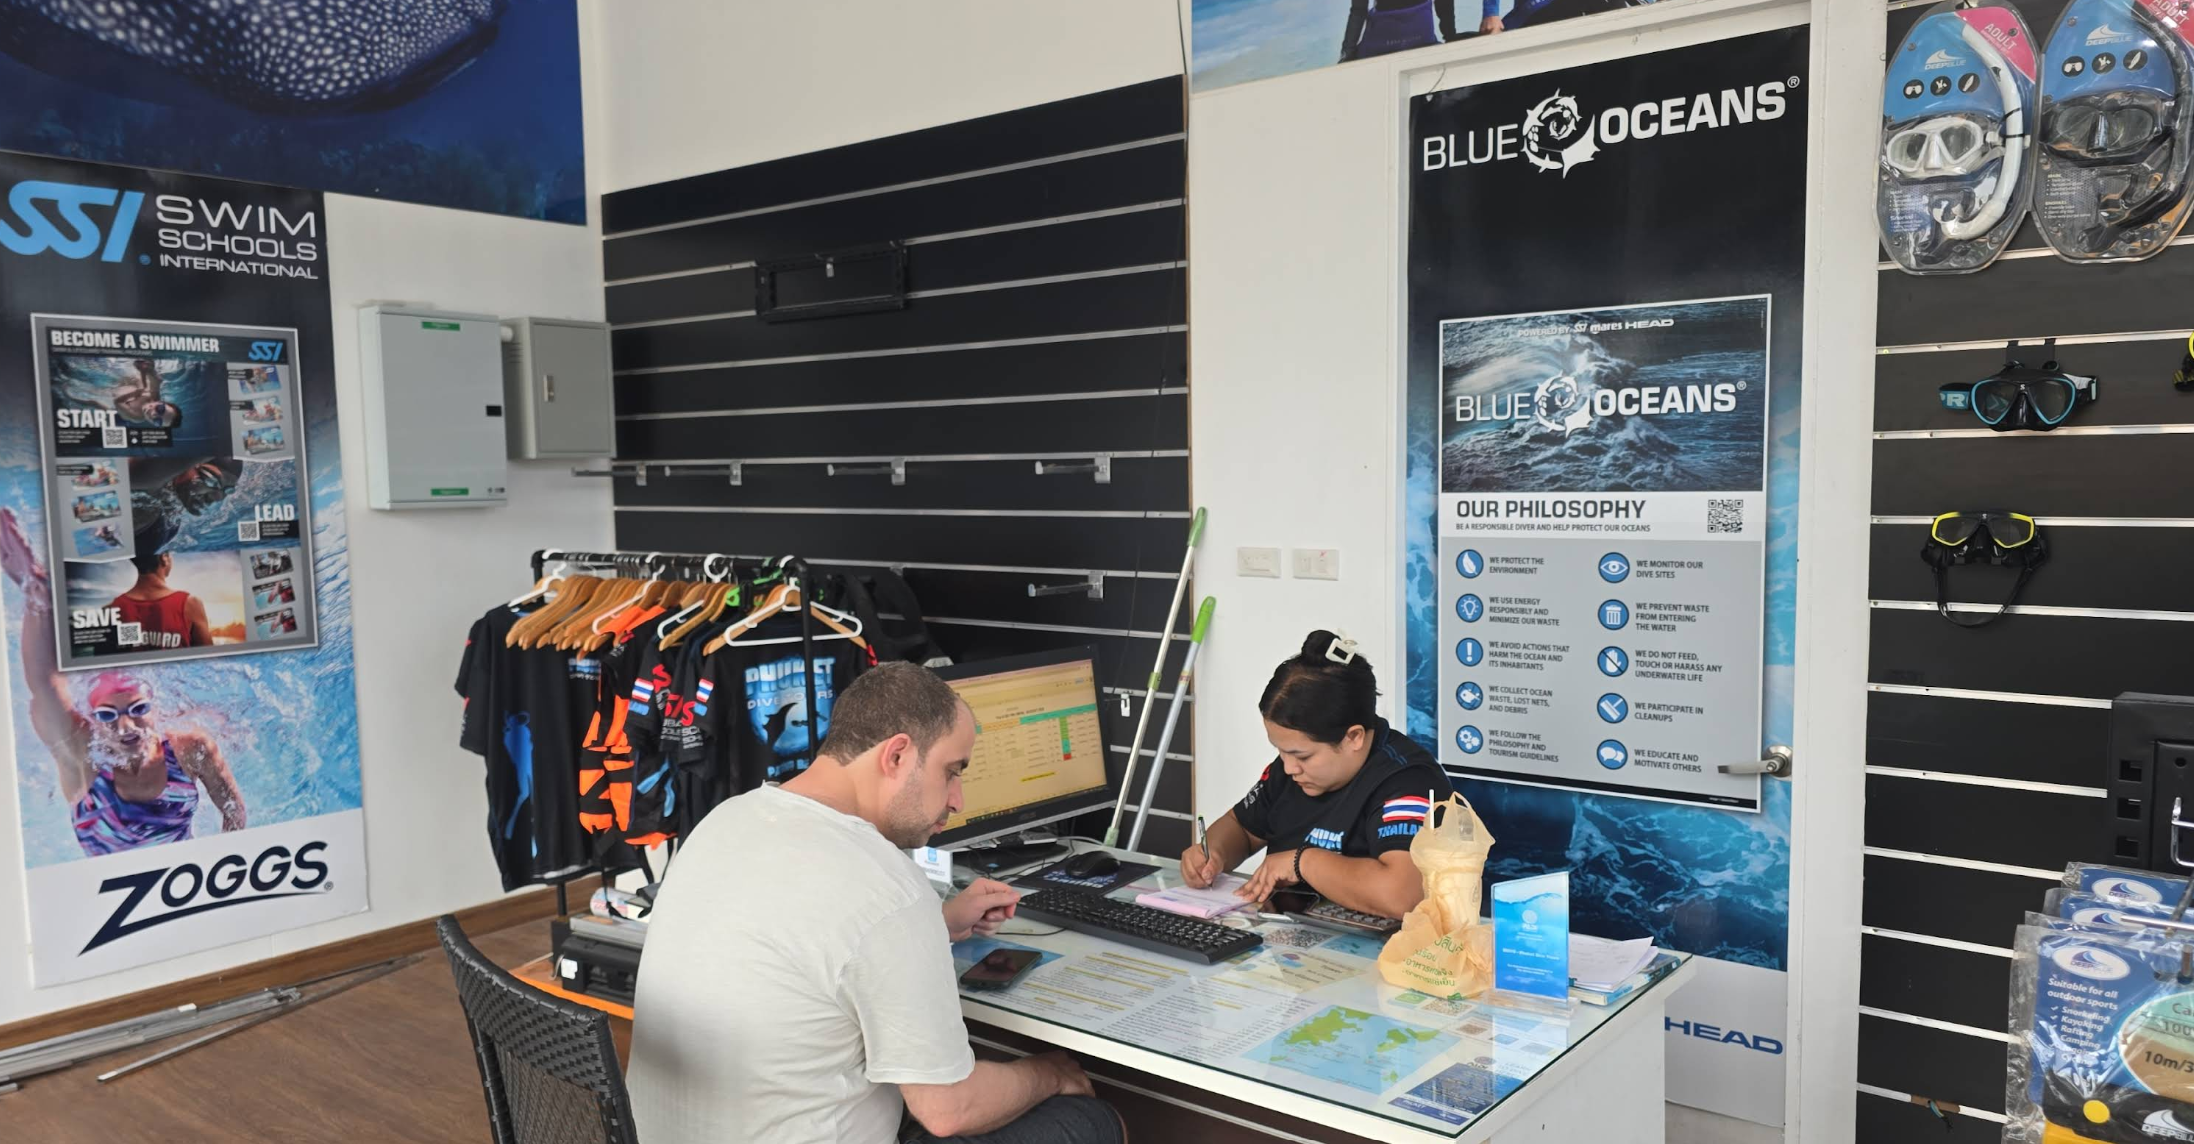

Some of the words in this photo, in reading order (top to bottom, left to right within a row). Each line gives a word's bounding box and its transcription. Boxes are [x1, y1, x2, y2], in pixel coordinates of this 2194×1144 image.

[1984, 23, 2017, 50] ADULT
[1423, 123, 1518, 171] BLUE
[0, 181, 145, 262] SSI
[156, 194, 317, 238] SWIM
[158, 228, 318, 262] SCHOOLS
[160, 253, 319, 279] INTERNATIONAL
[1518, 326, 1558, 337] POWERED
[1558, 326, 1570, 334] BY
[1590, 322, 1623, 334] mares
[1625, 318, 1674, 329] HEAD
[51, 330, 121, 349] BECOME
[124, 334, 136, 349] A
[139, 335, 219, 352] SWIMMER
[248, 341, 283, 361] SSI
[1456, 392, 1531, 422] BLUE
[57, 408, 118, 428] START
[254, 503, 295, 522] LEAD
[1456, 500, 1499, 518] OUR
[1505, 500, 1646, 519] PHILOSOPHY
[1471, 523, 1514, 531] RESPONSIBLE
[1515, 523, 1535, 531] DIVER
[1572, 524, 1602, 532] PROTECT
[1604, 524, 1620, 532] OUR
[1501, 557, 1530, 565] PROTECT
[1650, 560, 1685, 568] MONITOR
[1686, 561, 1703, 569] OUR
[1500, 597, 1513, 605] USE
[1514, 598, 1540, 606] ENERGY
[1649, 603, 1682, 611] PREVENT
[1683, 604, 1710, 612] WASTE
[1489, 606, 1532, 615] RESPONSIBLY
[73, 607, 121, 628] SAVE
[1489, 616, 1521, 624] MINIMIZE
[1522, 617, 1535, 625] OUR
[1536, 618, 1559, 626] WASTE
[1659, 614, 1696, 622] ENTERING
[1651, 623, 1676, 631] WATER
[1500, 642, 1521, 650] AVOID
[1522, 643, 1551, 651] ACTIONS
[1523, 653, 1546, 661] OCEAN
[1548, 654, 1563, 662] AND
[1661, 651, 1676, 659] NOT
[1678, 652, 1699, 661] FEED,
[1500, 661, 1544, 670] INHABITANTS
[1636, 660, 1660, 668] TOUCH
[1674, 663, 1705, 671] HARASS
[1635, 670, 1686, 680] UNDERWATER
[1687, 674, 1703, 682] LIFE
[1500, 686, 1528, 695] COLLECT
[1529, 688, 1553, 696] OCEAN
[1514, 697, 1530, 705] LOST
[1504, 706, 1528, 714] DEBRIS
[1647, 703, 1693, 713] PARTICIPATE
[1634, 712, 1673, 722] CLEANUPS
[1500, 731, 1527, 739] FOLLOW
[1489, 739, 1530, 749] PHILOSOPHY
[1489, 748, 1518, 758] TOURISM
[1519, 752, 1559, 762] GUIDELINES
[1634, 749, 1645, 757] WE
[1647, 750, 1681, 761] EDUCATE
[1682, 754, 1699, 762] AND
[1634, 759, 1671, 769] MOTIVATE
[1672, 762, 1702, 773] OTHERS
[1378, 822, 1420, 839] THAILA
[2048, 977, 2088, 993] Suitable
[2088, 985, 2103, 996] for
[2104, 990, 2118, 999] all
[2047, 989, 2085, 1004] outdoor
[2086, 997, 2118, 1011] sports
[2172, 1002, 2194, 1014] Ca
[2062, 1006, 2111, 1024] Snorkeling
[2061, 1015, 2104, 1031] Kayaking
[1664, 1016, 1783, 1055] HEAD
[2061, 1024, 2094, 1038] Rafting
[2060, 1034, 2101, 1051] Camping
[2142, 1123, 2194, 1143] DEEPBLU
